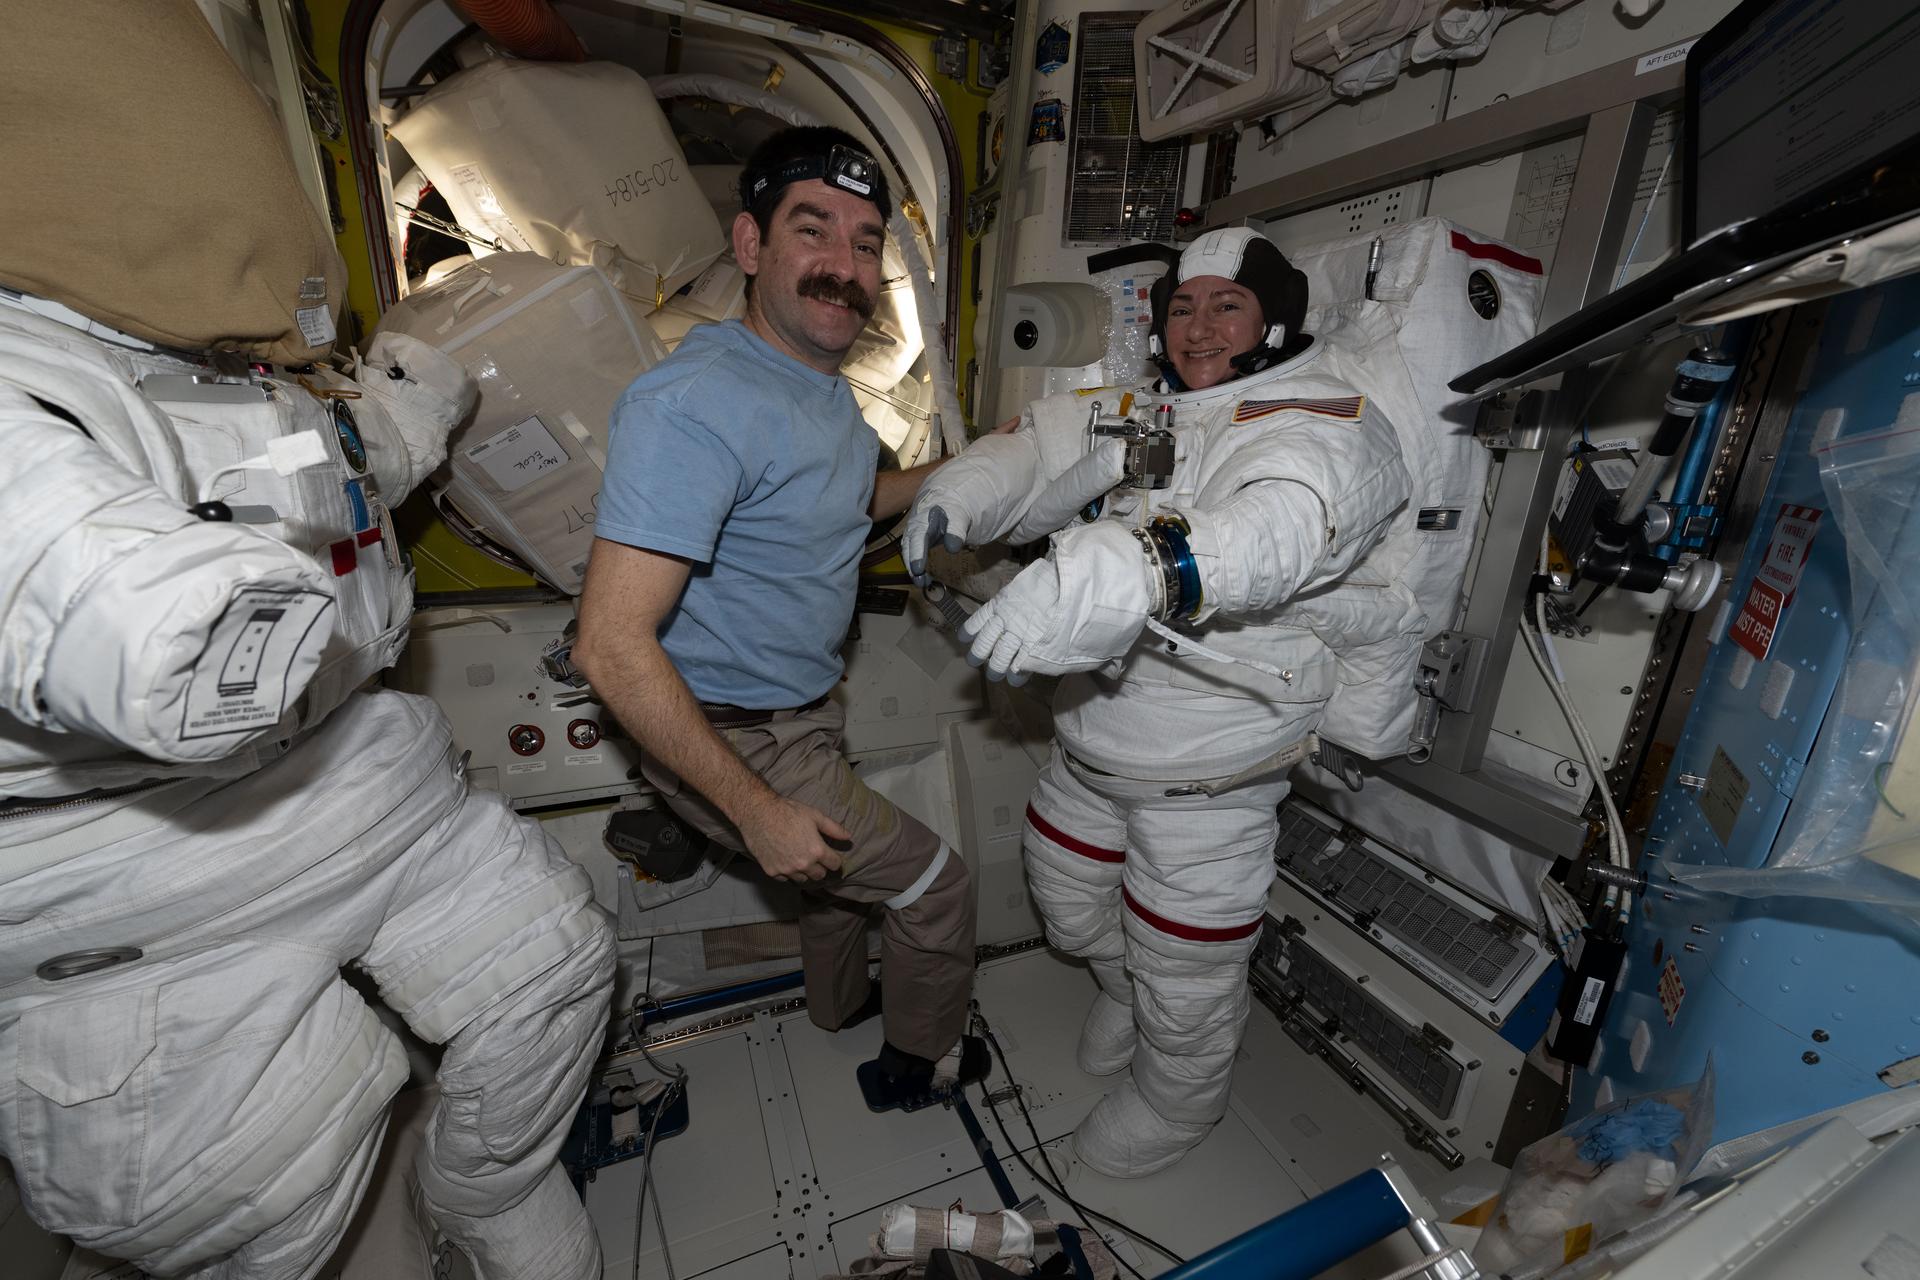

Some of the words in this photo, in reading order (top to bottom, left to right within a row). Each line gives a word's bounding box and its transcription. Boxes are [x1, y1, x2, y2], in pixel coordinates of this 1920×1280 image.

[1646, 55, 1663, 66] AFT
[604, 158, 680, 208] 20-5184
[538, 455, 559, 471] Meir
[1782, 522, 1807, 540] PORTABLE
[1776, 543, 1796, 564] FIRE
[1764, 564, 1794, 586] EXTINGUISHER
[1749, 586, 1776, 620] WATER
[1735, 608, 1754, 635] MIST
[1751, 620, 1772, 648] PFE
